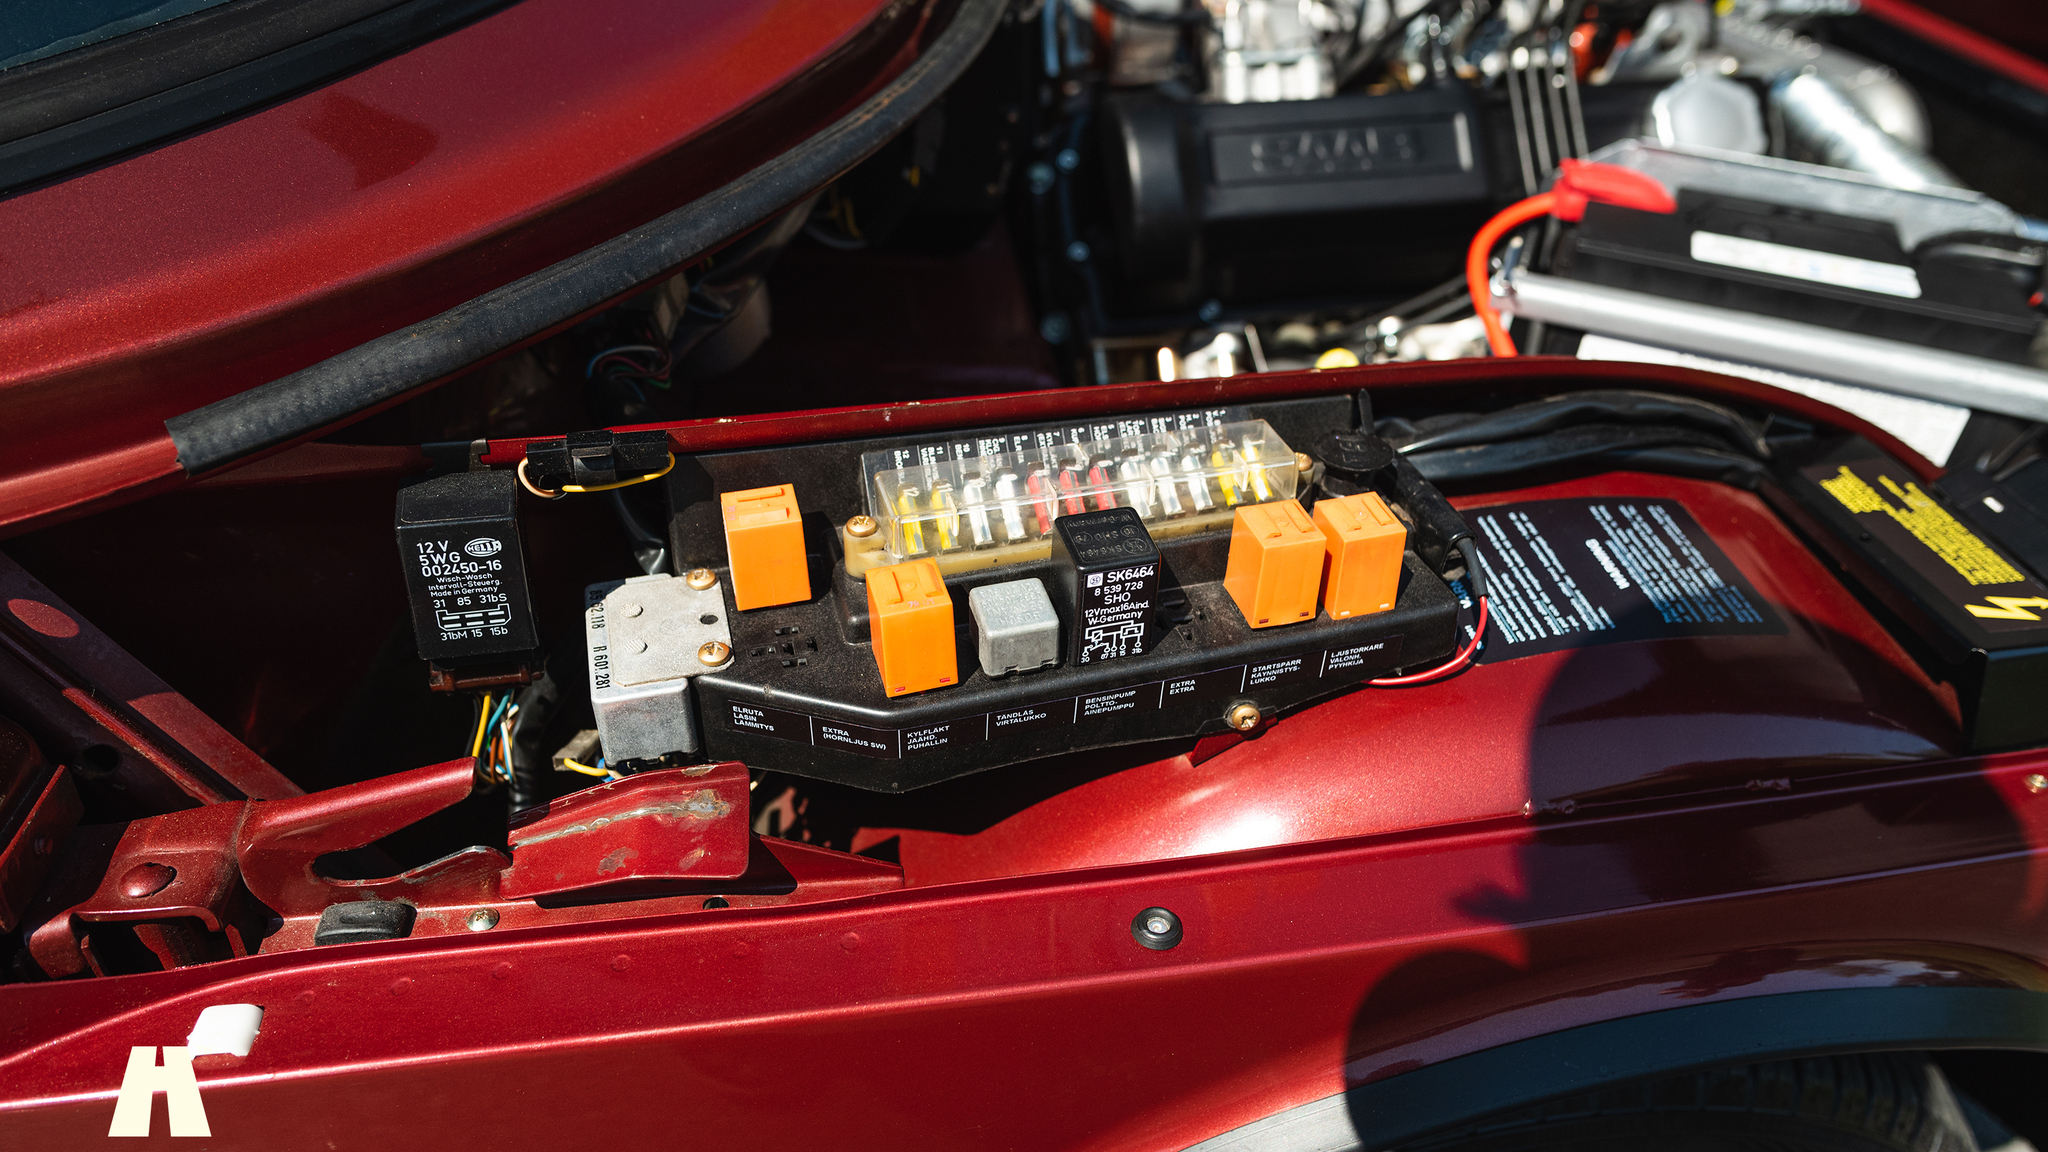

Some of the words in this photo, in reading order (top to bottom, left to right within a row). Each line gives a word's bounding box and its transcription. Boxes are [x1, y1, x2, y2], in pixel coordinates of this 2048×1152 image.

[936, 446, 944, 455] 11
[963, 443, 970, 452] 10
[902, 450, 910, 459] 12
[416, 542, 434, 554] 12
[438, 540, 448, 552] V
[466, 539, 502, 554] HELLA
[422, 560, 502, 577] 002450-16
[1107, 566, 1154, 583] SK6464
[436, 572, 492, 584] Wisch-Wasch
[428, 579, 502, 590] Intervall-Steuerg.
[462, 586, 498, 594] Germany
[1094, 588, 1100, 596] 8
[1104, 584, 1122, 594] 539
[1124, 580, 1144, 590] 728
[433, 598, 446, 608] 31
[456, 596, 472, 606] 85
[1104, 592, 1131, 604] SHO
[1088, 610, 1143, 626] W-Germany
[440, 630, 468, 641] 31bM
[470, 628, 483, 638] 15
[490, 626, 508, 636] 15b
[1331, 643, 1384, 658] LJUSTORKARE
[1328, 658, 1364, 670] PYYHKIJA
[1170, 680, 1196, 689] EXTRA
[1250, 676, 1276, 685] LUKKO
[1170, 686, 1195, 695] EXTRA
[1086, 690, 1136, 704] BENSINPUMP
[732, 706, 764, 717] ELRUTA
[1084, 702, 1135, 716] AINEPUMPPU
[733, 712, 757, 722] LASIN
[996, 712, 1046, 727] VIRTALUKKO
[822, 726, 850, 736] EXTRA
[908, 738, 948, 750] PUHALLIN
